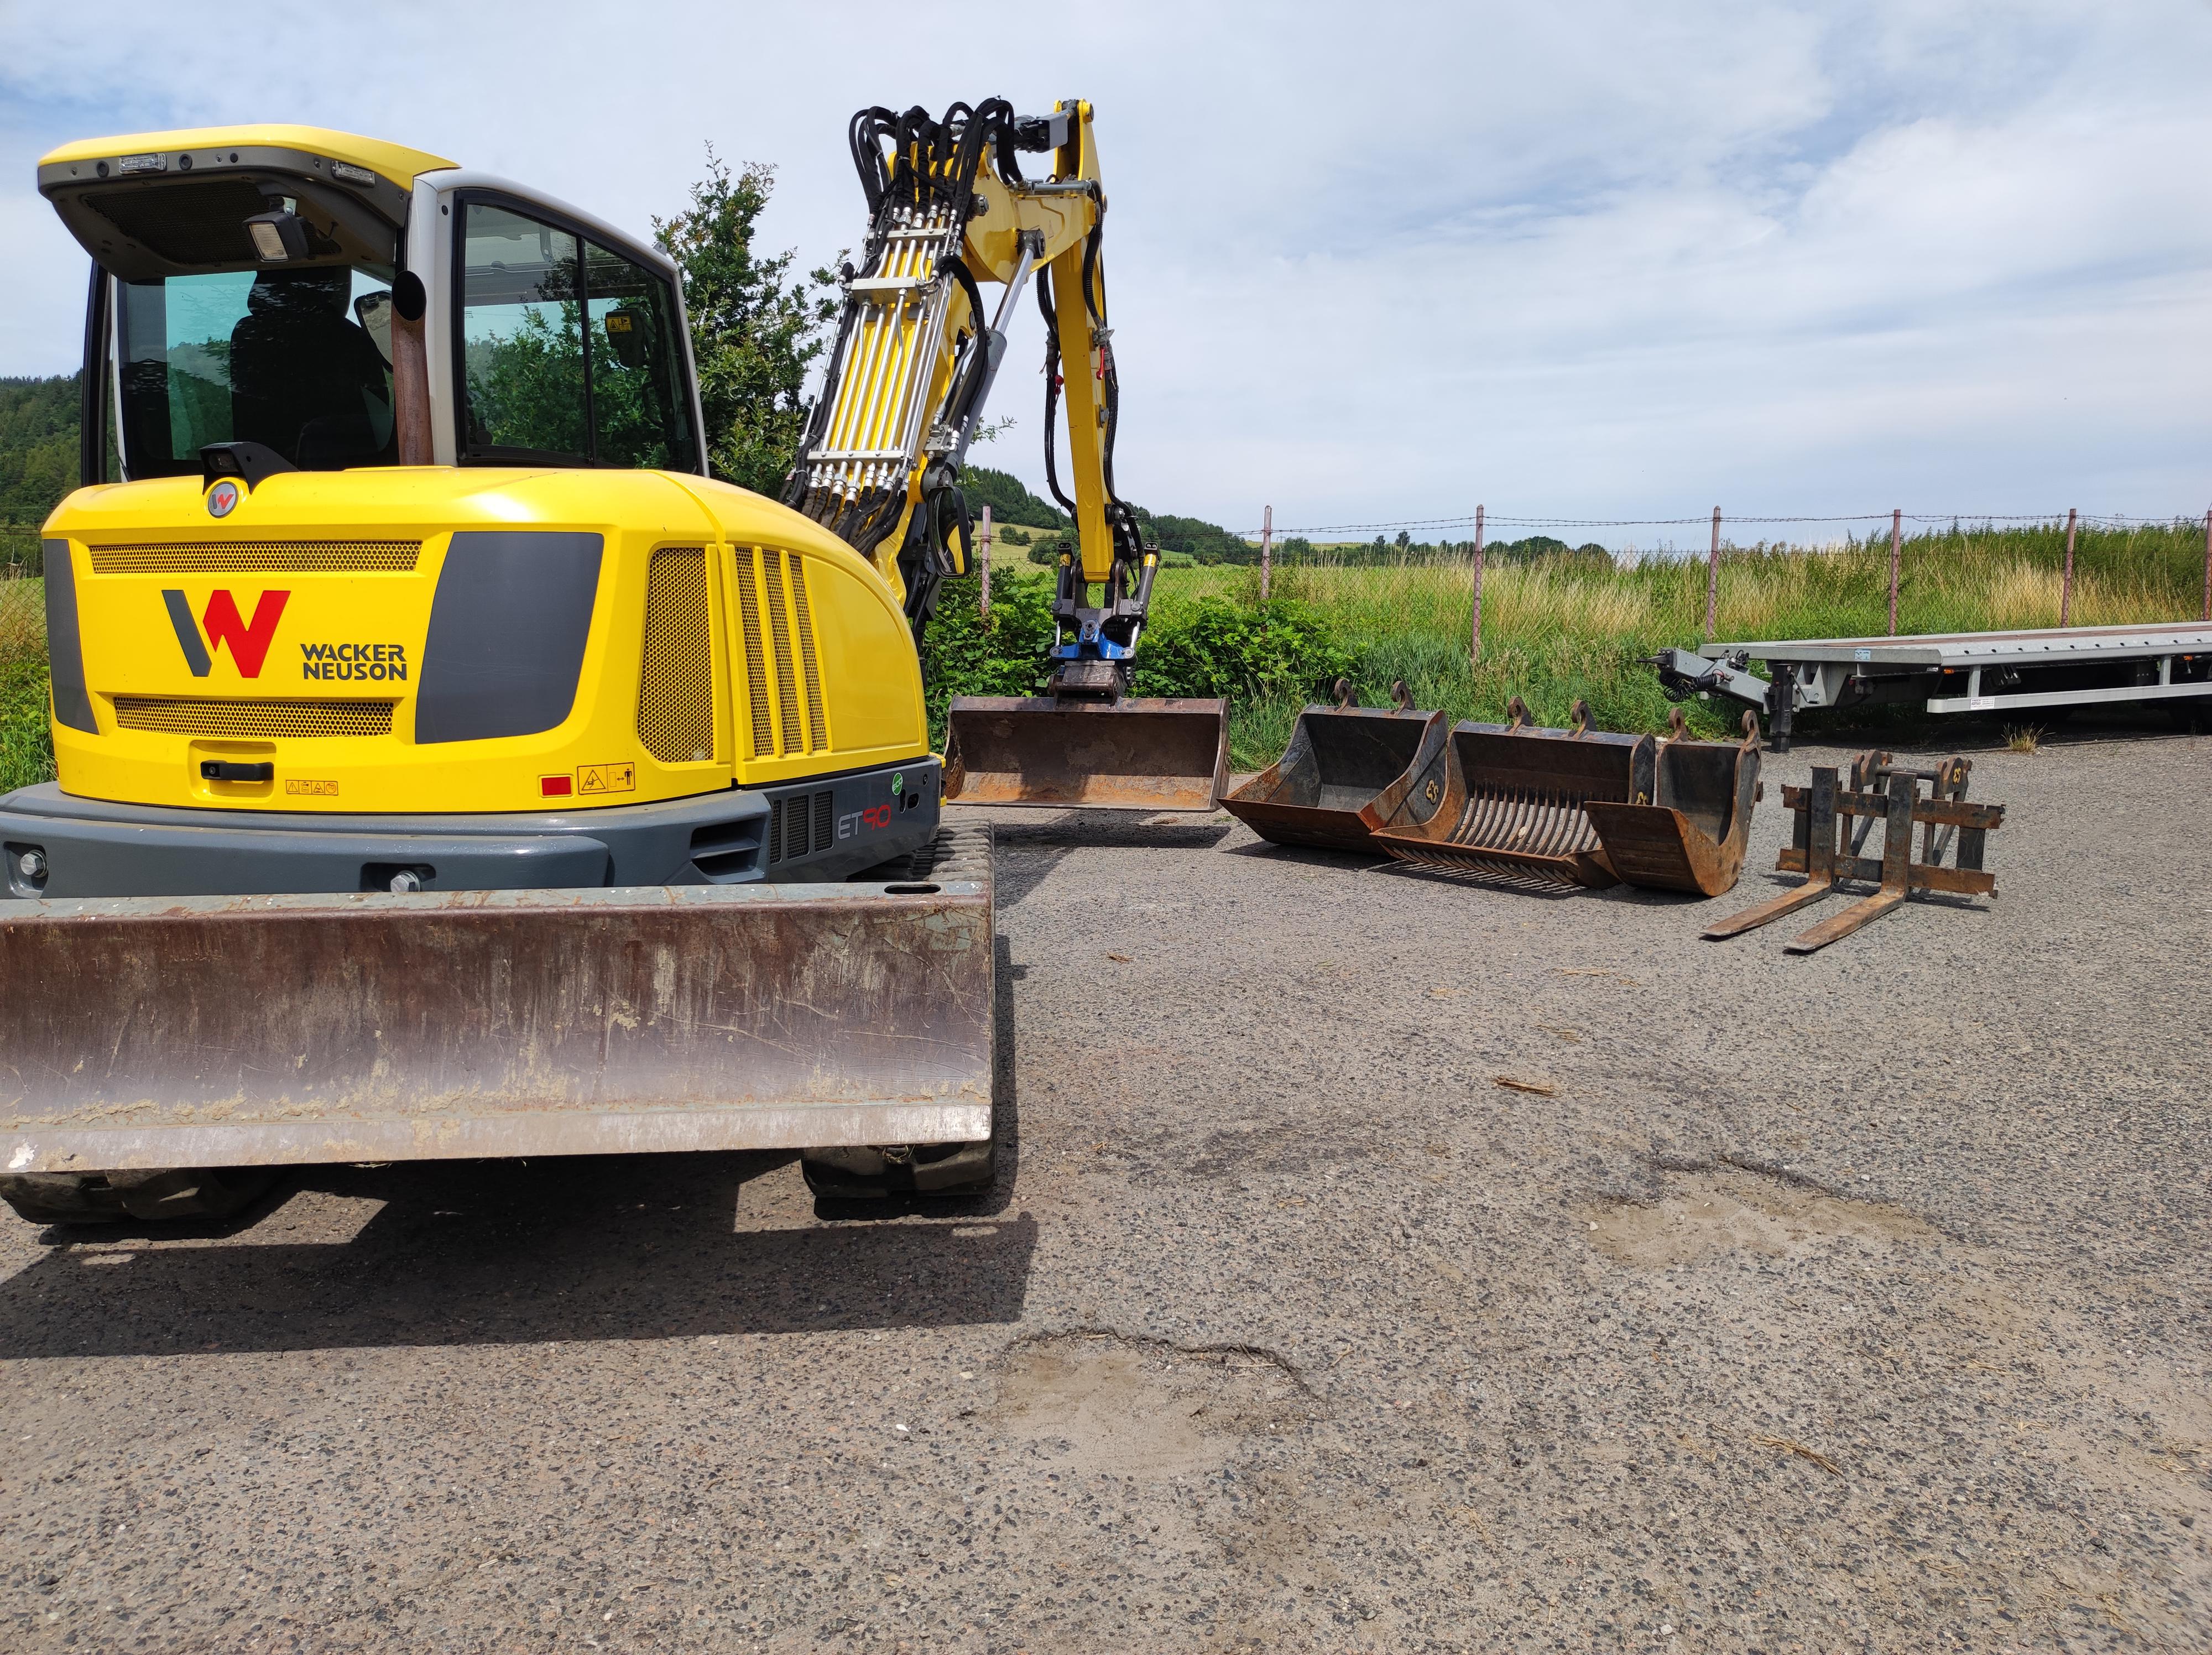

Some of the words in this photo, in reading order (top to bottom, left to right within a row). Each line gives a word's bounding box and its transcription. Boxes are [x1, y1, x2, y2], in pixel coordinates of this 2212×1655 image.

[300, 643, 407, 662] WACKER
[303, 662, 408, 681] NEUSON
[893, 777, 903, 791] ECO
[838, 804, 891, 840] ET90
